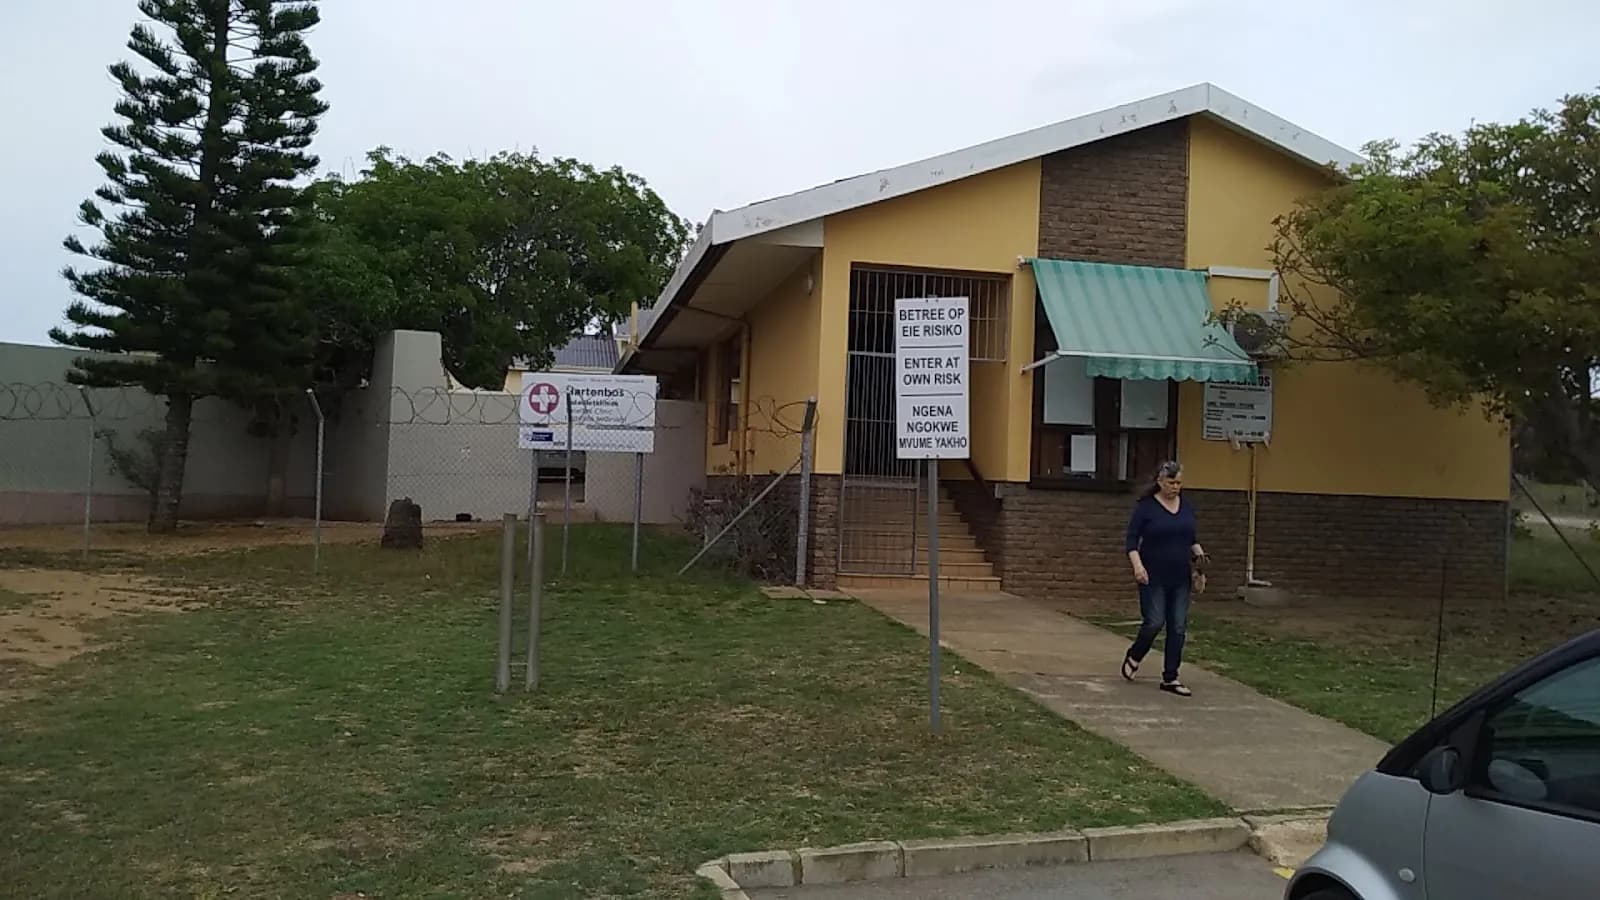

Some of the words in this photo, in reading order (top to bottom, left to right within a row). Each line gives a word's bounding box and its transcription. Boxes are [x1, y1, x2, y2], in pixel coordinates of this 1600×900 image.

[899, 308, 945, 321] BETREE
[948, 307, 965, 320] OP
[902, 325, 920, 337] EIE
[923, 324, 962, 337] RISIKO
[904, 357, 942, 369] ENTER
[945, 356, 960, 369] AT
[903, 373, 931, 386] OWN
[934, 372, 961, 385] RISK
[912, 405, 953, 417] NGENA
[906, 421, 959, 433] NGOKWE
[899, 437, 932, 449] MVUME
[935, 436, 967, 448] YAKHO
